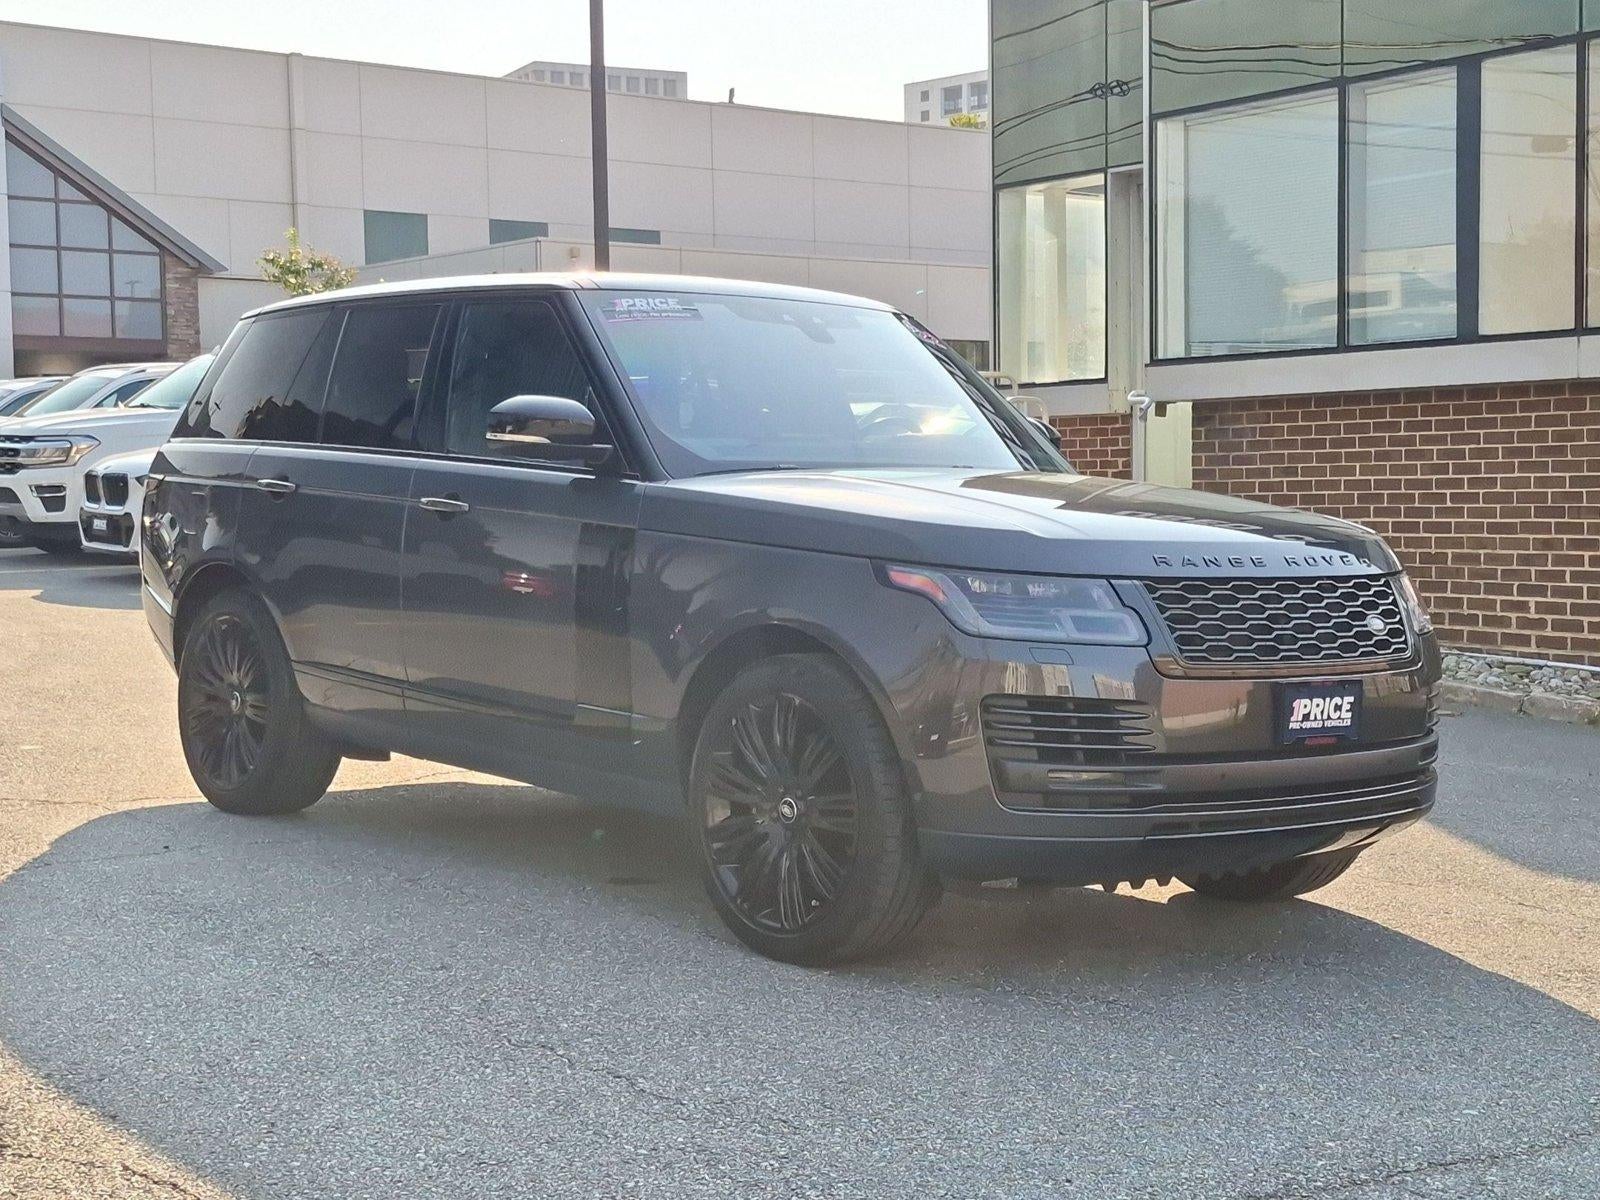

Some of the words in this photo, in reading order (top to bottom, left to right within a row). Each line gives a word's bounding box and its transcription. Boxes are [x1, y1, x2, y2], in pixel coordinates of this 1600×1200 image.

[1153, 553, 1268, 568] RANGE
[1284, 554, 1372, 568] ROVER
[1290, 696, 1354, 722] 1PRICE
[1324, 718, 1352, 728] VEHICLES
